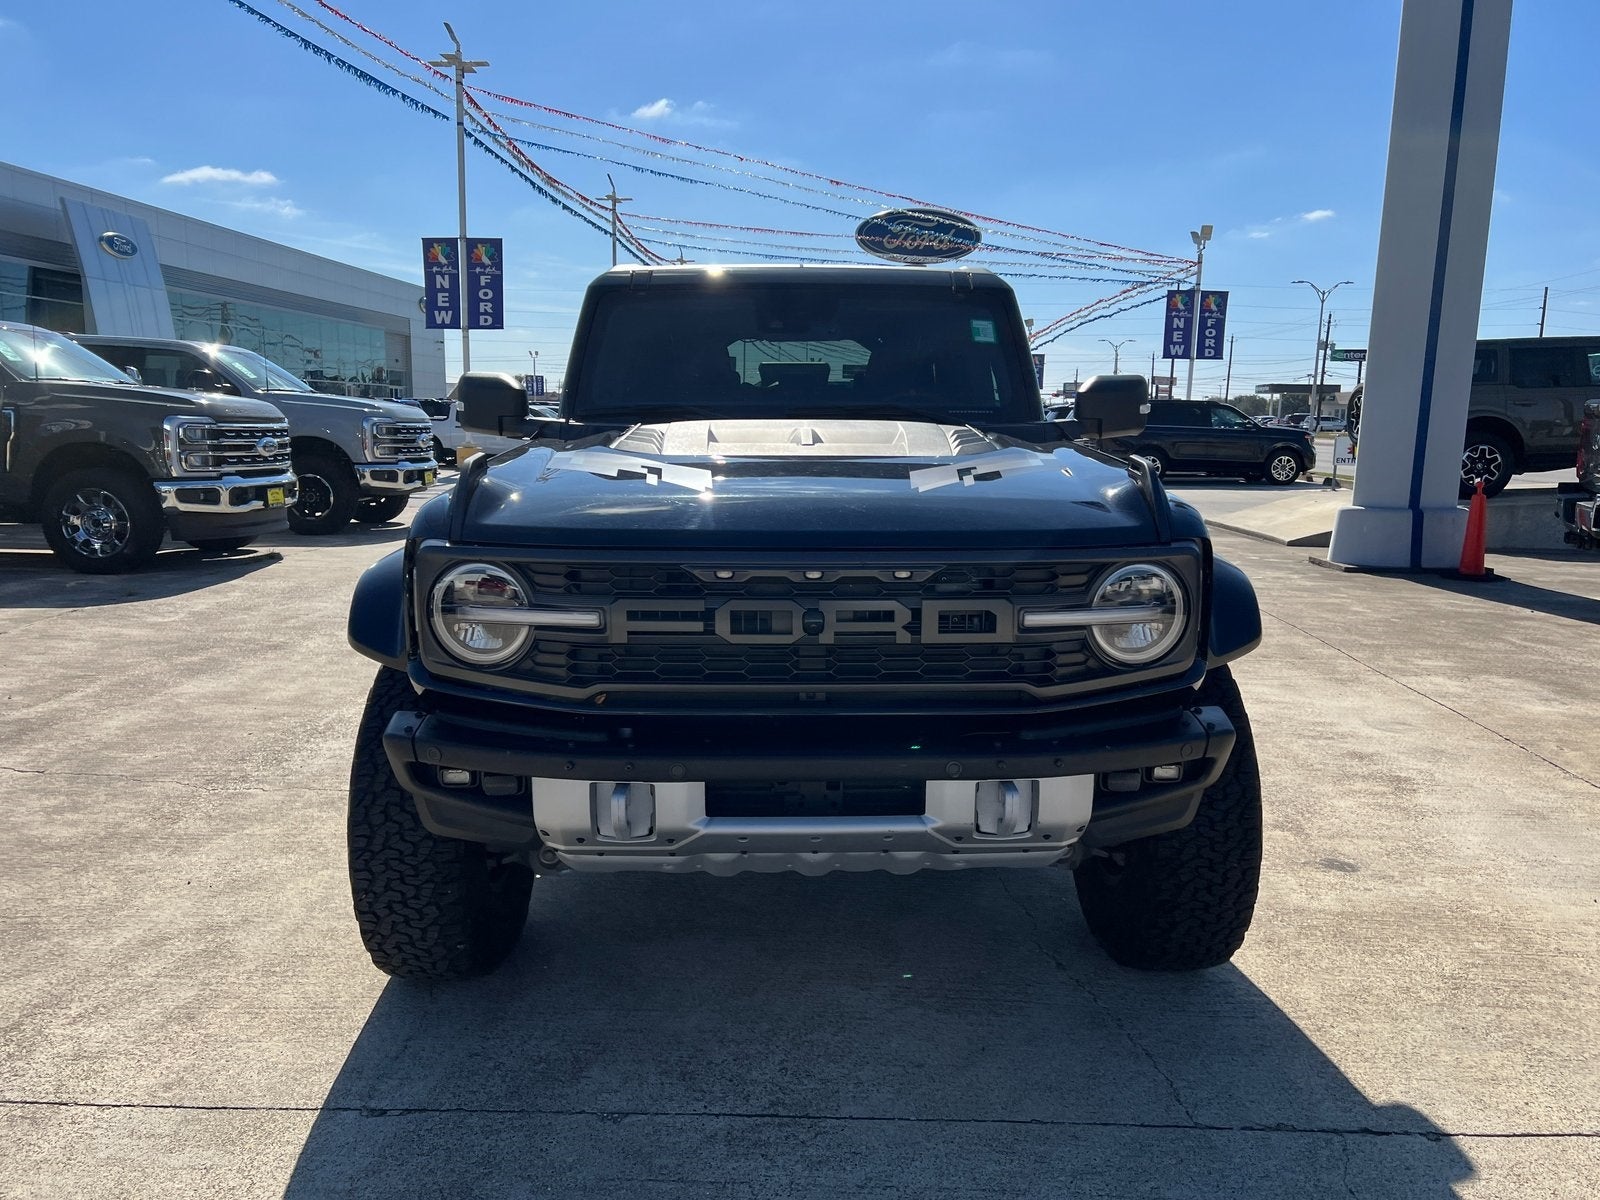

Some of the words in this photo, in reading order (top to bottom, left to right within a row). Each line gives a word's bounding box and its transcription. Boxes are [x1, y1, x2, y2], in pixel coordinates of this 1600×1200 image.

[112, 237, 132, 253] Ford
[883, 219, 956, 250] Ford
[434, 274, 452, 325] NEW
[478, 275, 493, 326] FORD
[1169, 317, 1185, 356] NEW
[1204, 318, 1217, 357] FORD
[607, 599, 1016, 645] FORD
